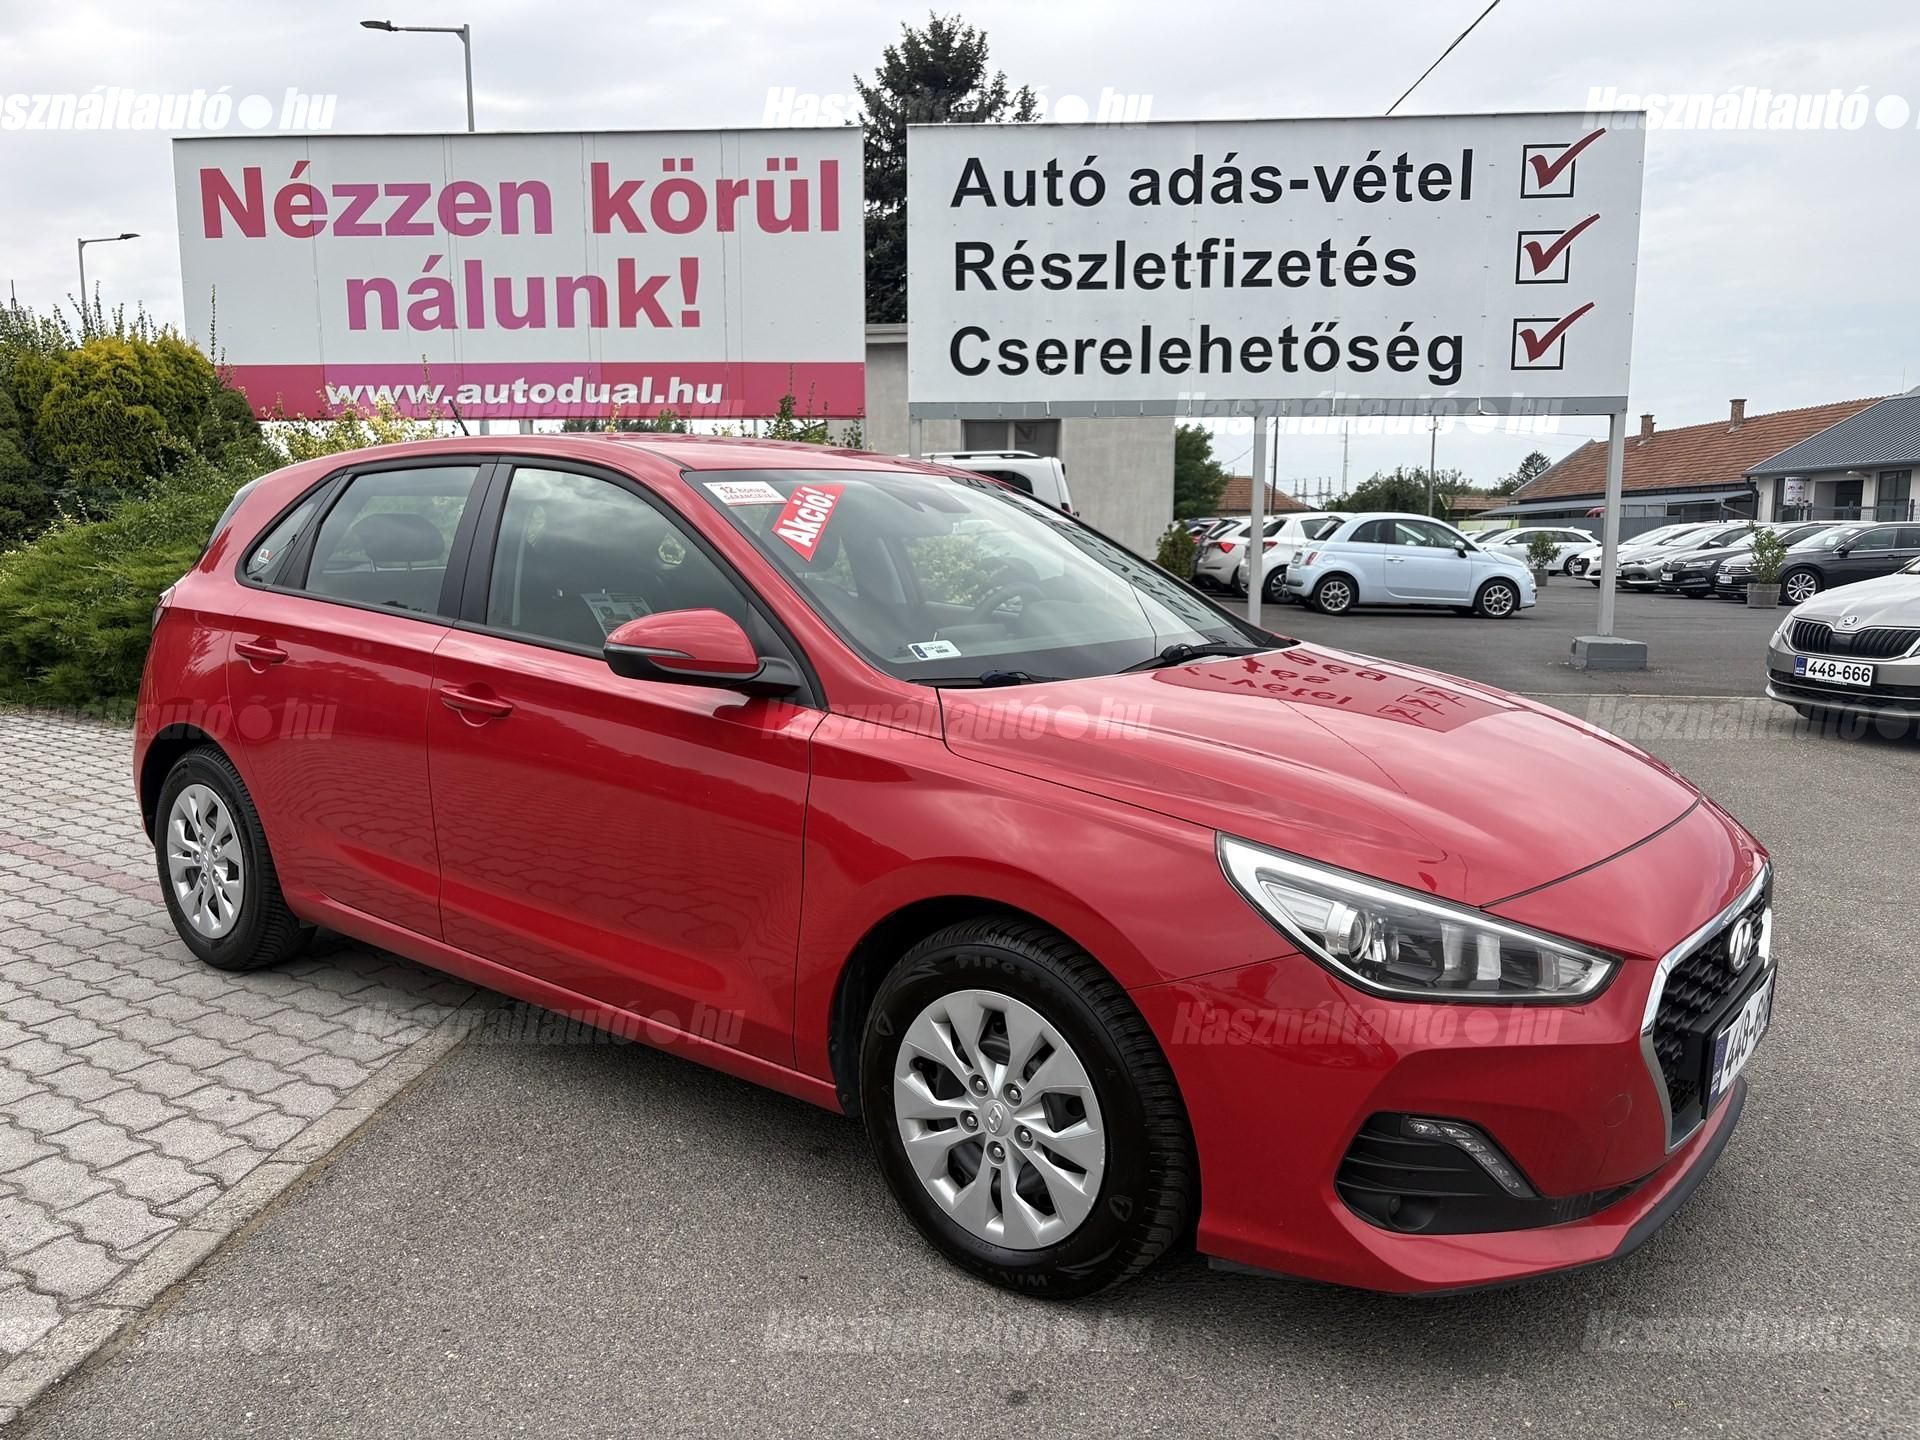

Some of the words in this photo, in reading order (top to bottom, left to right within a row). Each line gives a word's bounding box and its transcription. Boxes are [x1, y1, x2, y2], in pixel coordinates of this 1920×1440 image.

[200, 161, 551, 238] Nézzen
[592, 158, 838, 233] körül
[951, 156, 1105, 207] Autó
[1129, 149, 1472, 206] adás-vétel
[956, 236, 1416, 290] Részletfizetés
[347, 256, 699, 330] nálunk!
[951, 322, 1462, 385] Cserelehetőség
[325, 377, 723, 405] www.autodual.hu
[720, 486, 737, 495] 12
[777, 486, 836, 548] Akció!
[1808, 661, 1871, 683] 448-666
